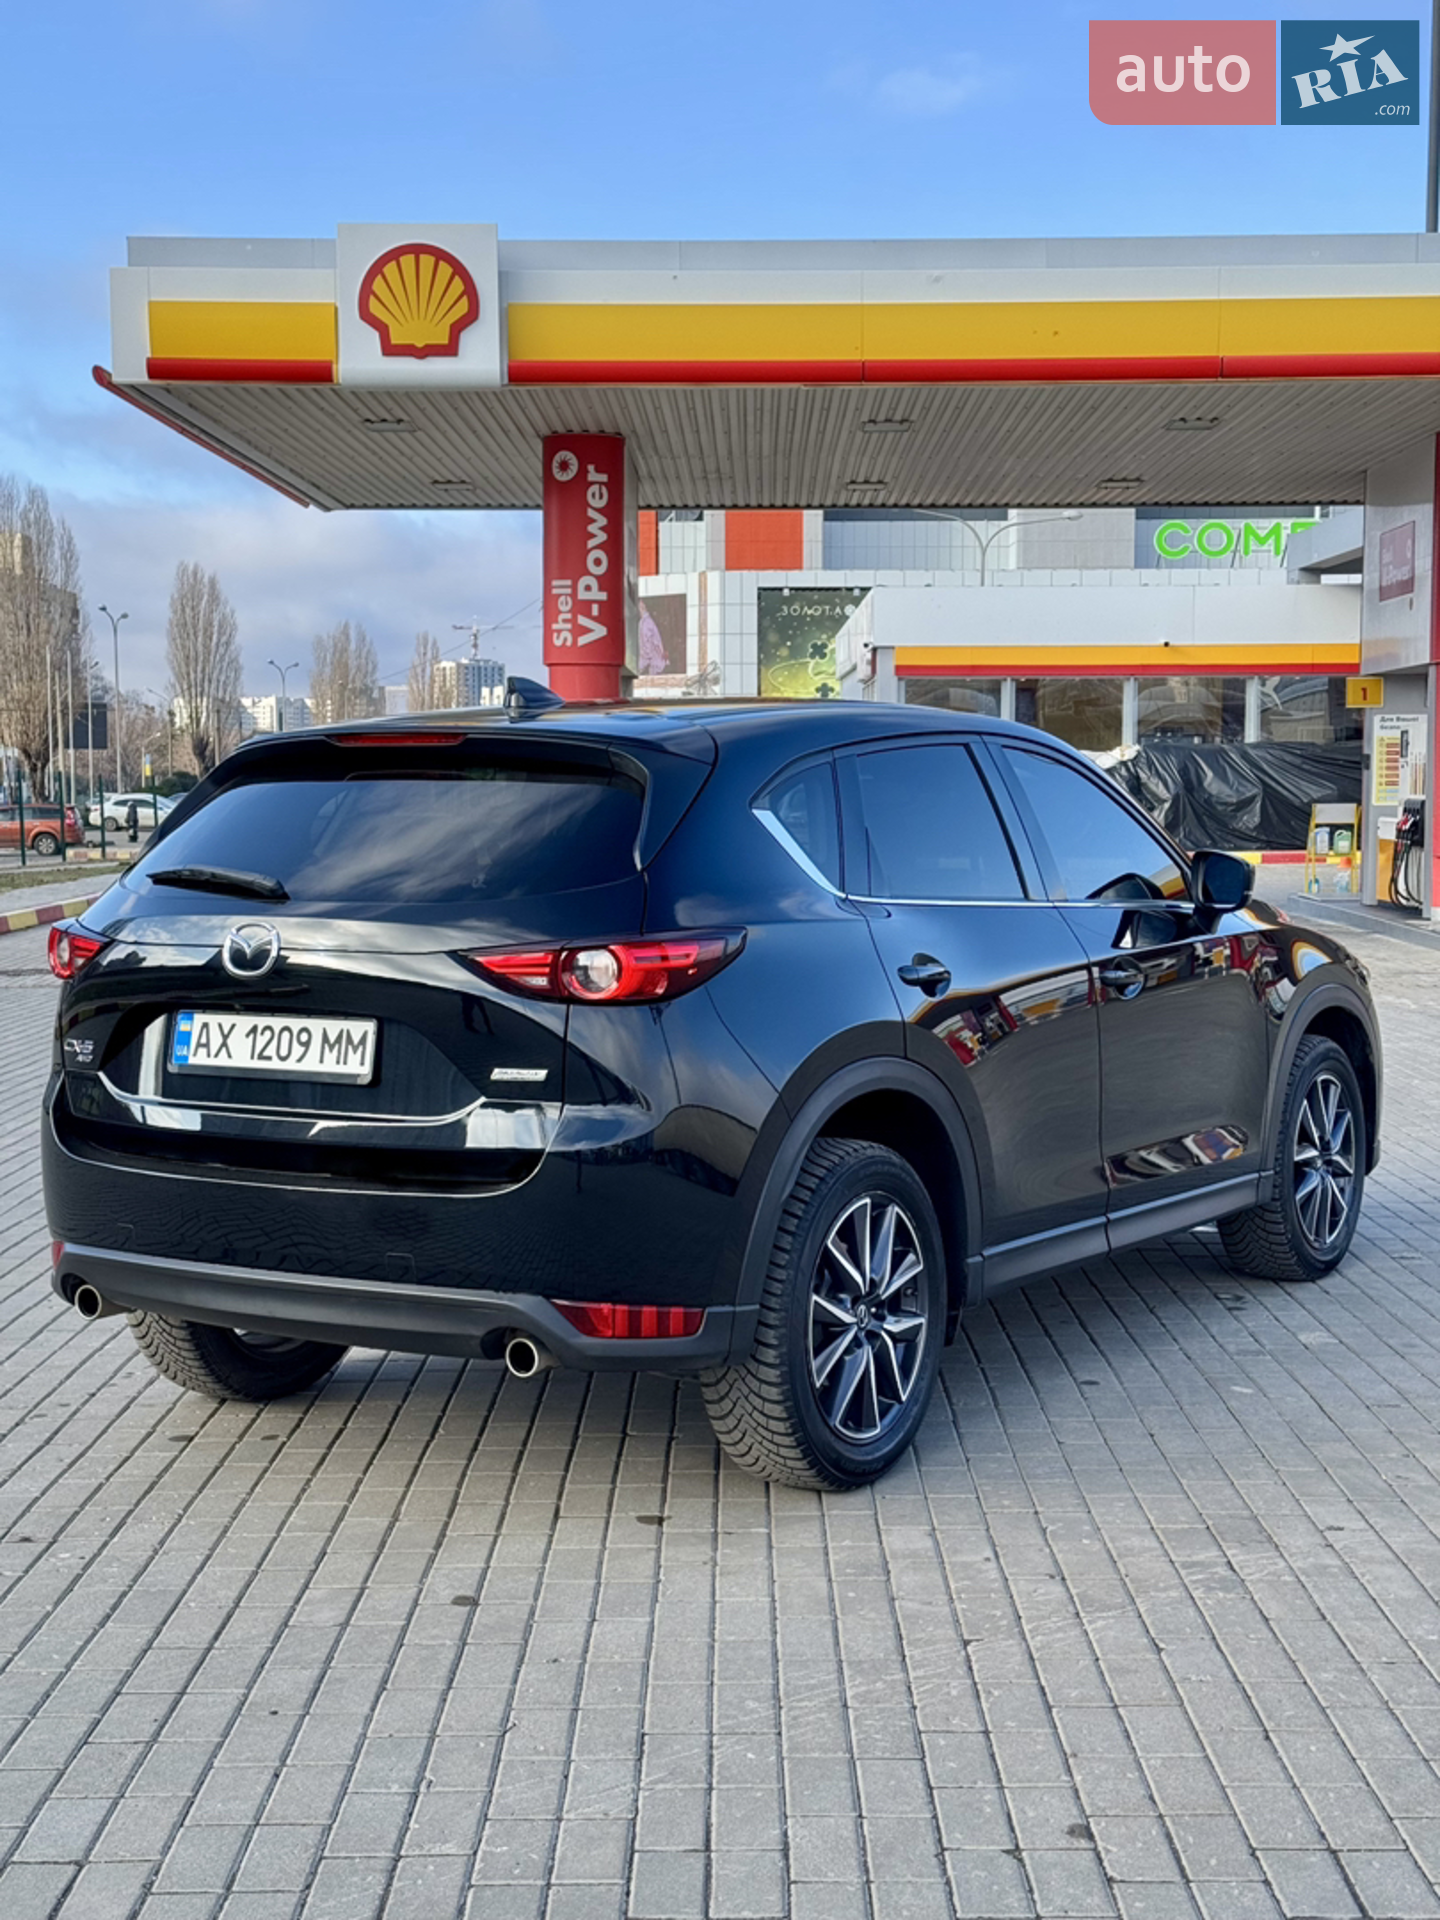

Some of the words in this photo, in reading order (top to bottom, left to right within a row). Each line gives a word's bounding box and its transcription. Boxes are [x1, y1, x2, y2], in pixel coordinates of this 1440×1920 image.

[577, 464, 609, 647] V-Power
[551, 579, 573, 647] Shell
[1361, 687, 1368, 701] 1
[193, 1022, 237, 1059] AX
[245, 1023, 313, 1063] 1209
[319, 1027, 368, 1066] MM
